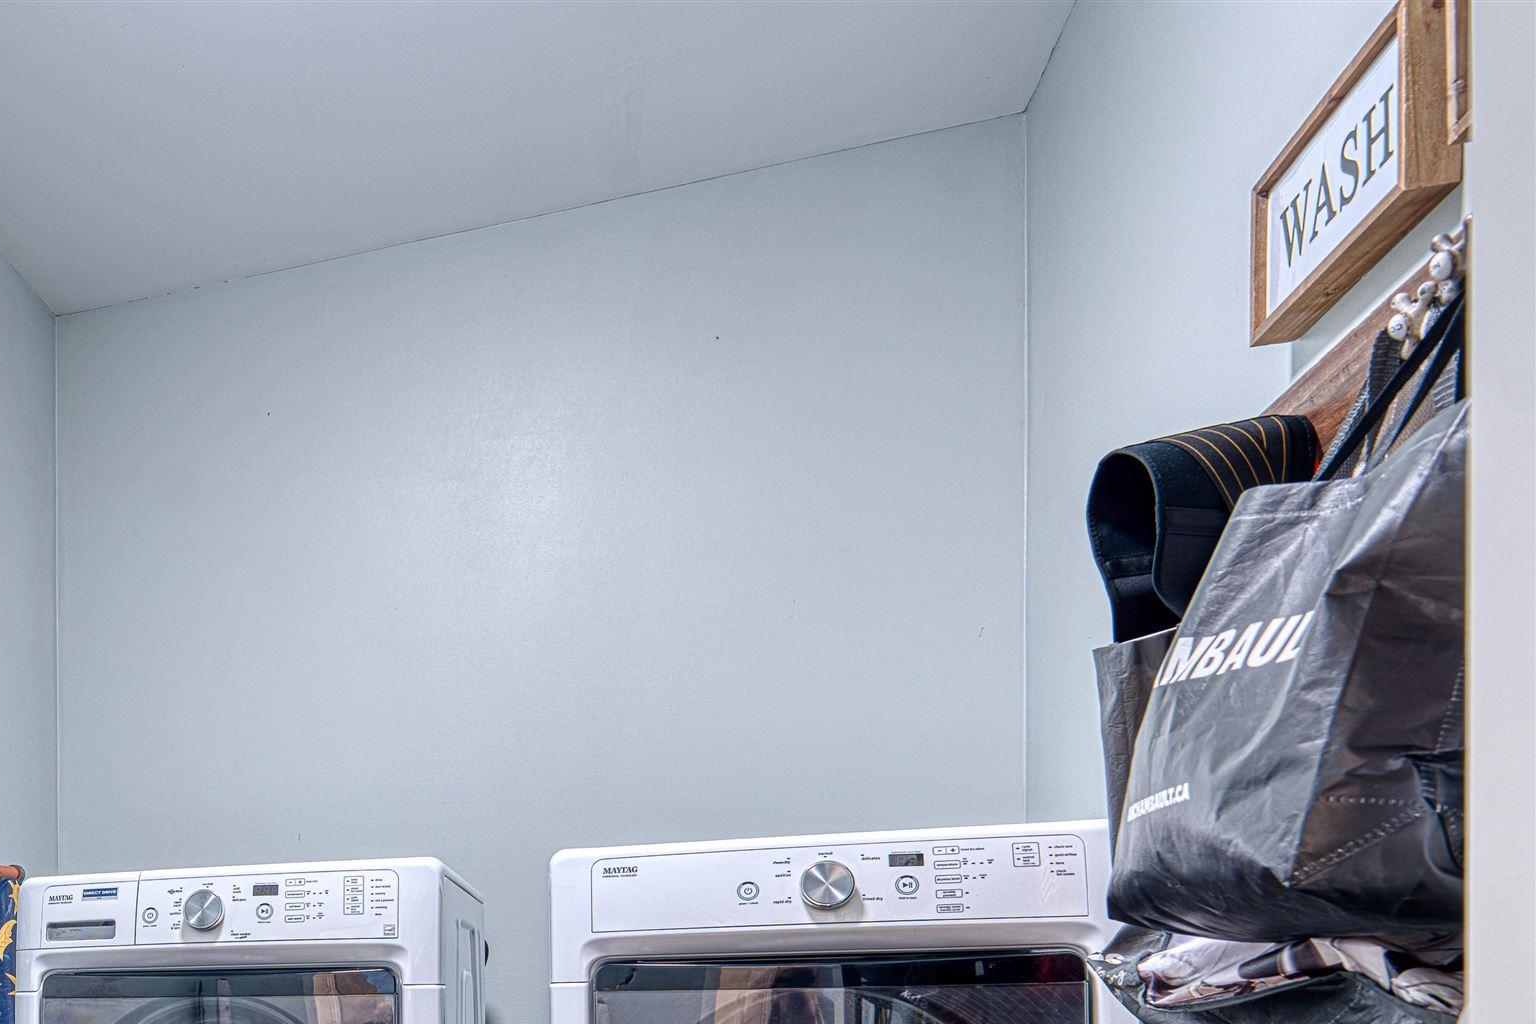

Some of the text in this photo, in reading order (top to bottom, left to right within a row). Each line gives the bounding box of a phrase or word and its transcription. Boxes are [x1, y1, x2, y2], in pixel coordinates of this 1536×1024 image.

[1279, 83, 1394, 268] WASH
[602, 866, 638, 875] MAYTAG
[48, 894, 73, 902] MAYTAG
